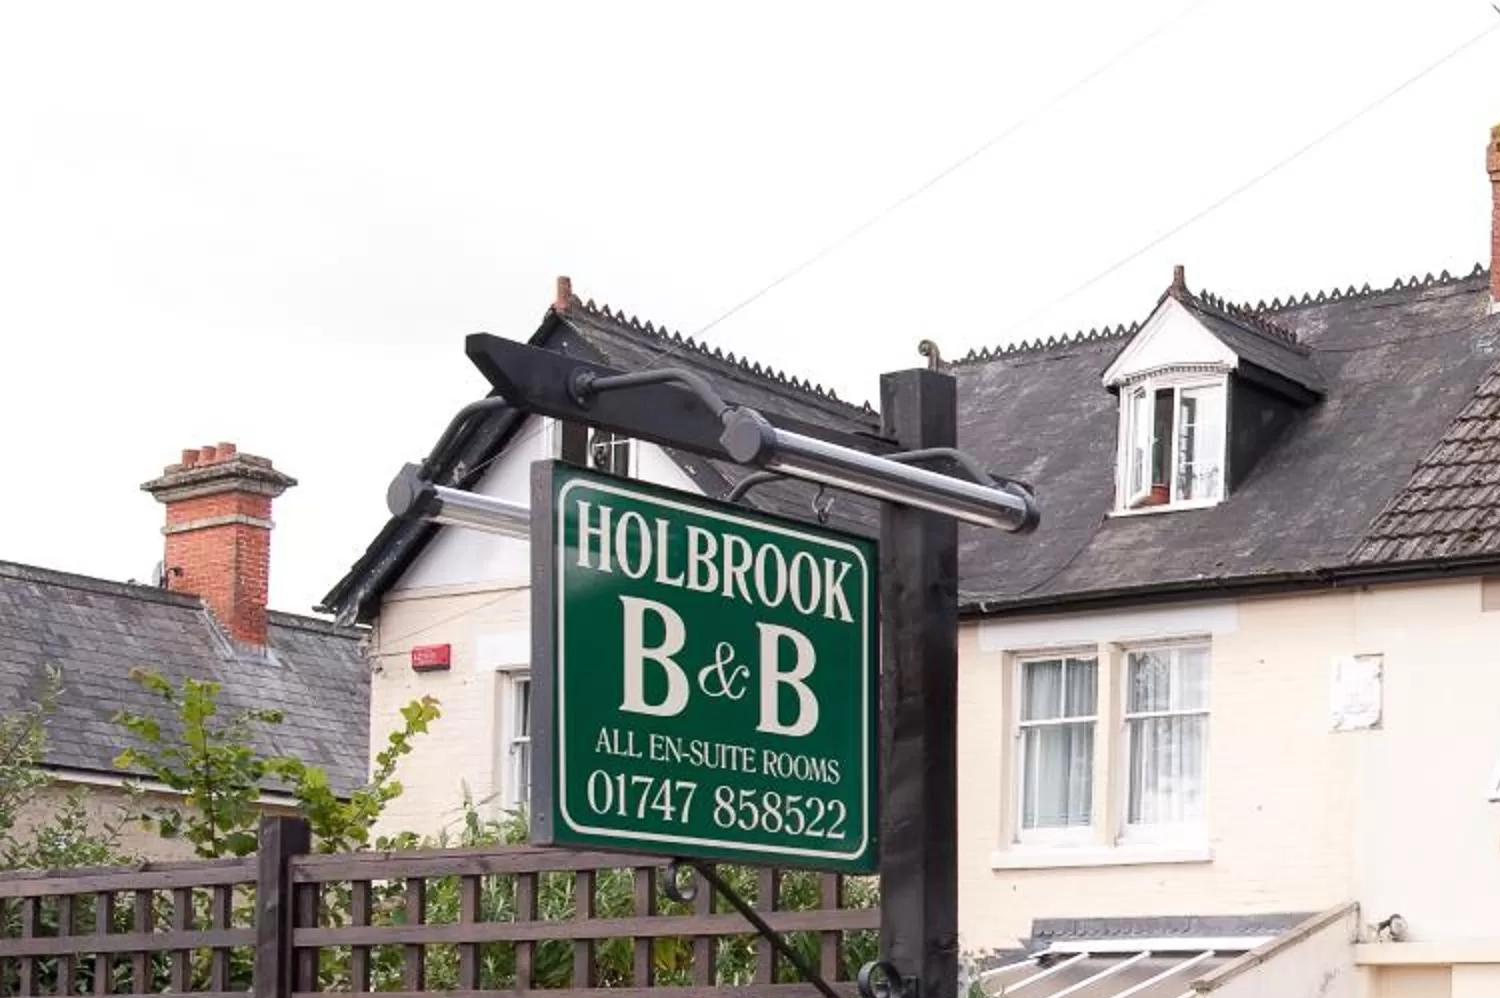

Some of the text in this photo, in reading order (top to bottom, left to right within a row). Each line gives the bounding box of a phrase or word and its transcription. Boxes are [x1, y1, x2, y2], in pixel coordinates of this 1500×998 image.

[576, 500, 854, 624] HOLBROOK
[595, 727, 840, 785] ALL EN-SUITE ROOMS
[587, 769, 847, 840] 01747 858522
